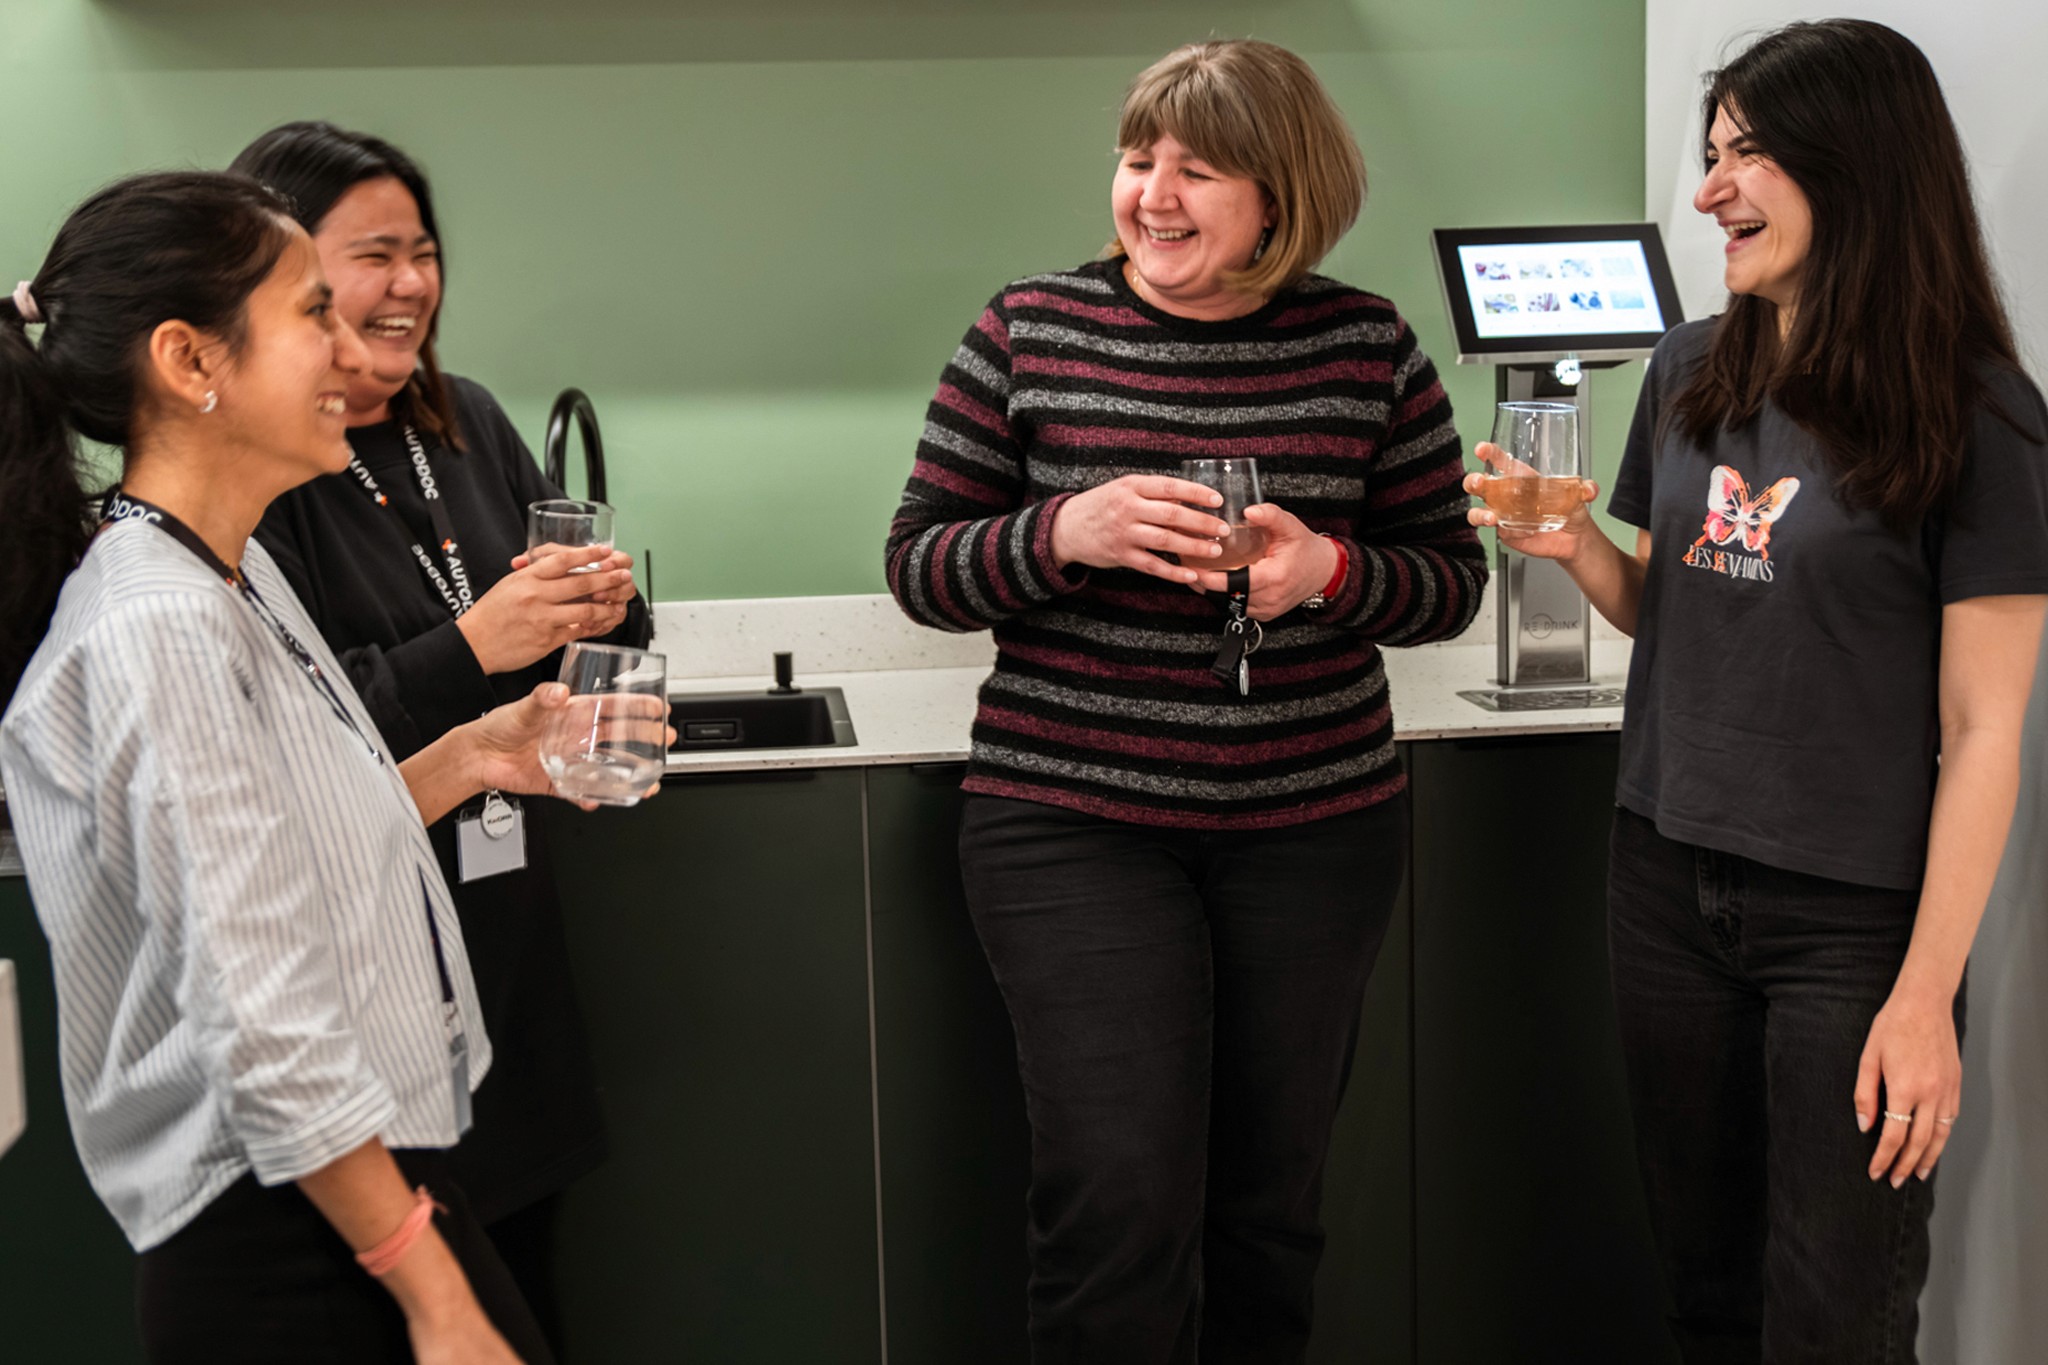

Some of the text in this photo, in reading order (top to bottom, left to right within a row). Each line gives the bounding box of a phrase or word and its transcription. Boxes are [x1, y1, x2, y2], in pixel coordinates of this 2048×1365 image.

[349, 450, 378, 489] AUT
[404, 425, 439, 500] AUTODOC
[1544, 620, 1578, 630] DRINK
